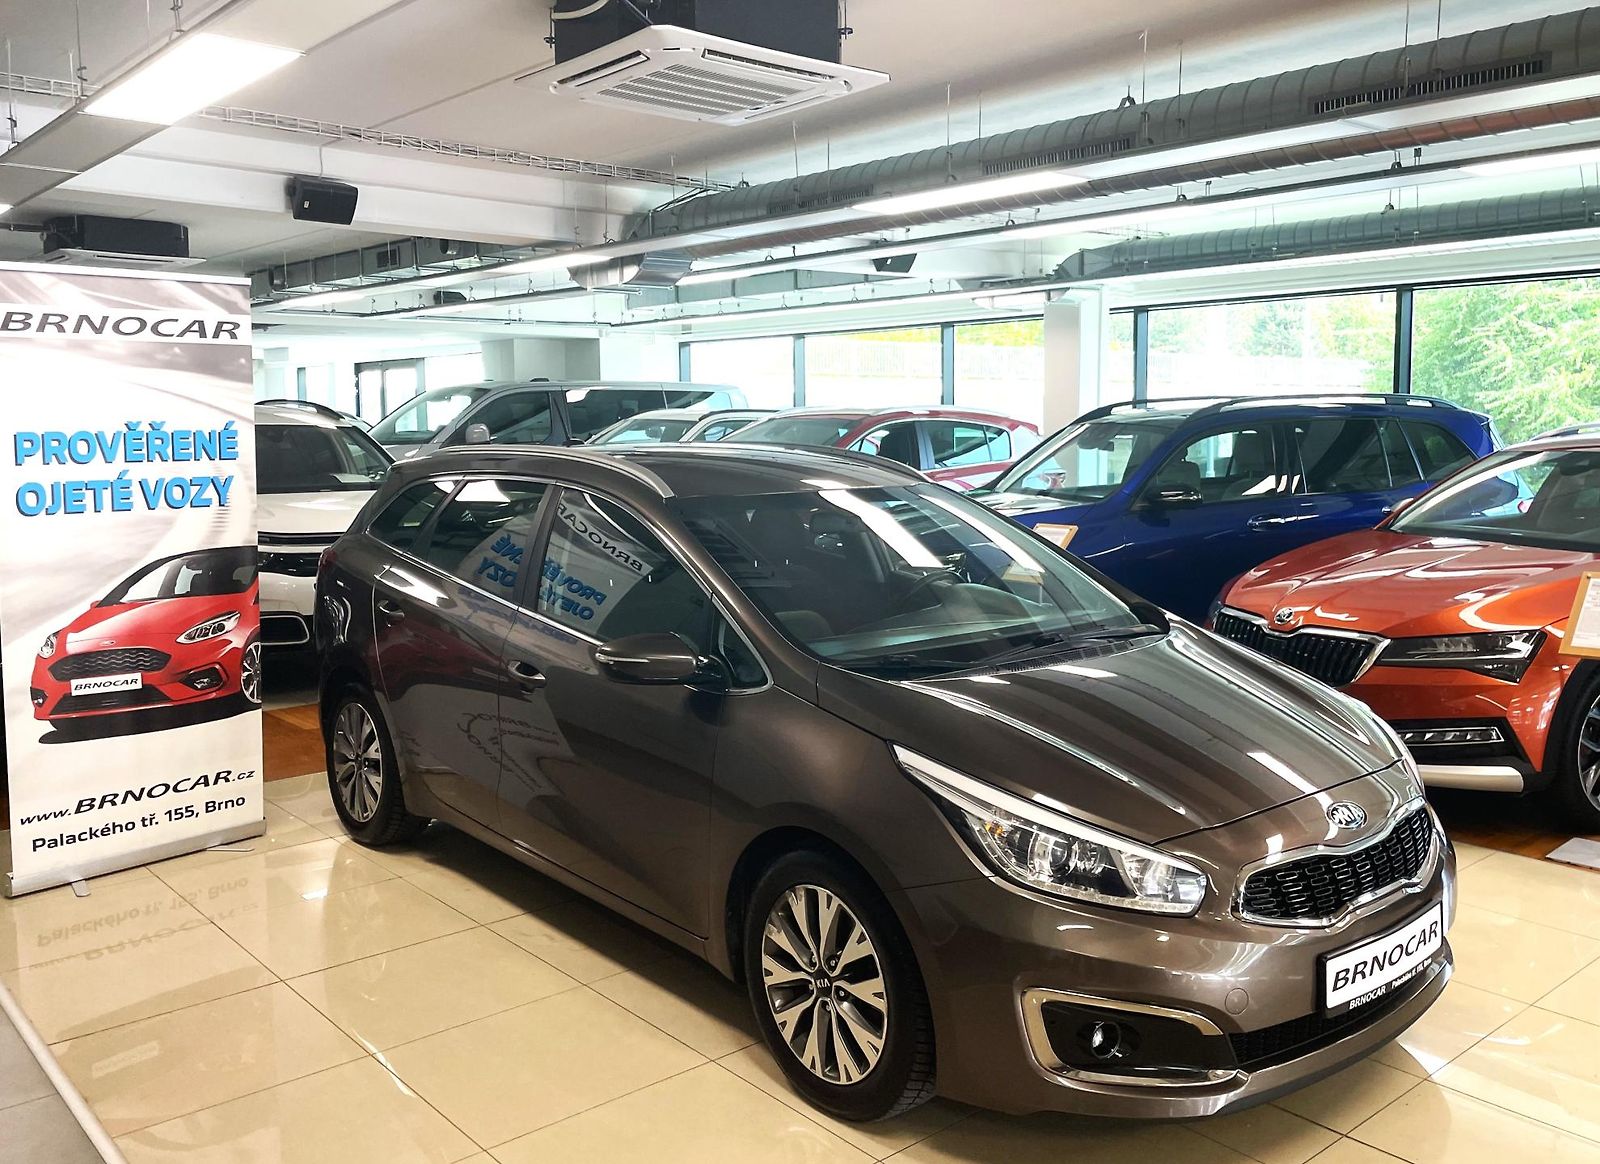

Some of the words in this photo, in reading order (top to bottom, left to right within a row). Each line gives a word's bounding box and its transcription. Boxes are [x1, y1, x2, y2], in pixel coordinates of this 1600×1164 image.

[0, 311, 241, 340] BRNOCAR
[13, 420, 239, 466] PROVĚŘENÉ
[15, 469, 135, 517] OJETÉ
[138, 474, 235, 510] VOZY
[73, 677, 140, 692] BRNOCAR
[19, 770, 256, 826] www.BRNOCAR.cz
[31, 820, 137, 852] Palackého
[140, 813, 160, 827] tř.
[164, 804, 201, 824] 155,
[204, 796, 246, 814] Brno
[1331, 919, 1439, 993] BRNOCAR
[815, 978, 831, 989] KIA
[1348, 985, 1387, 1010] BRNOCAR
